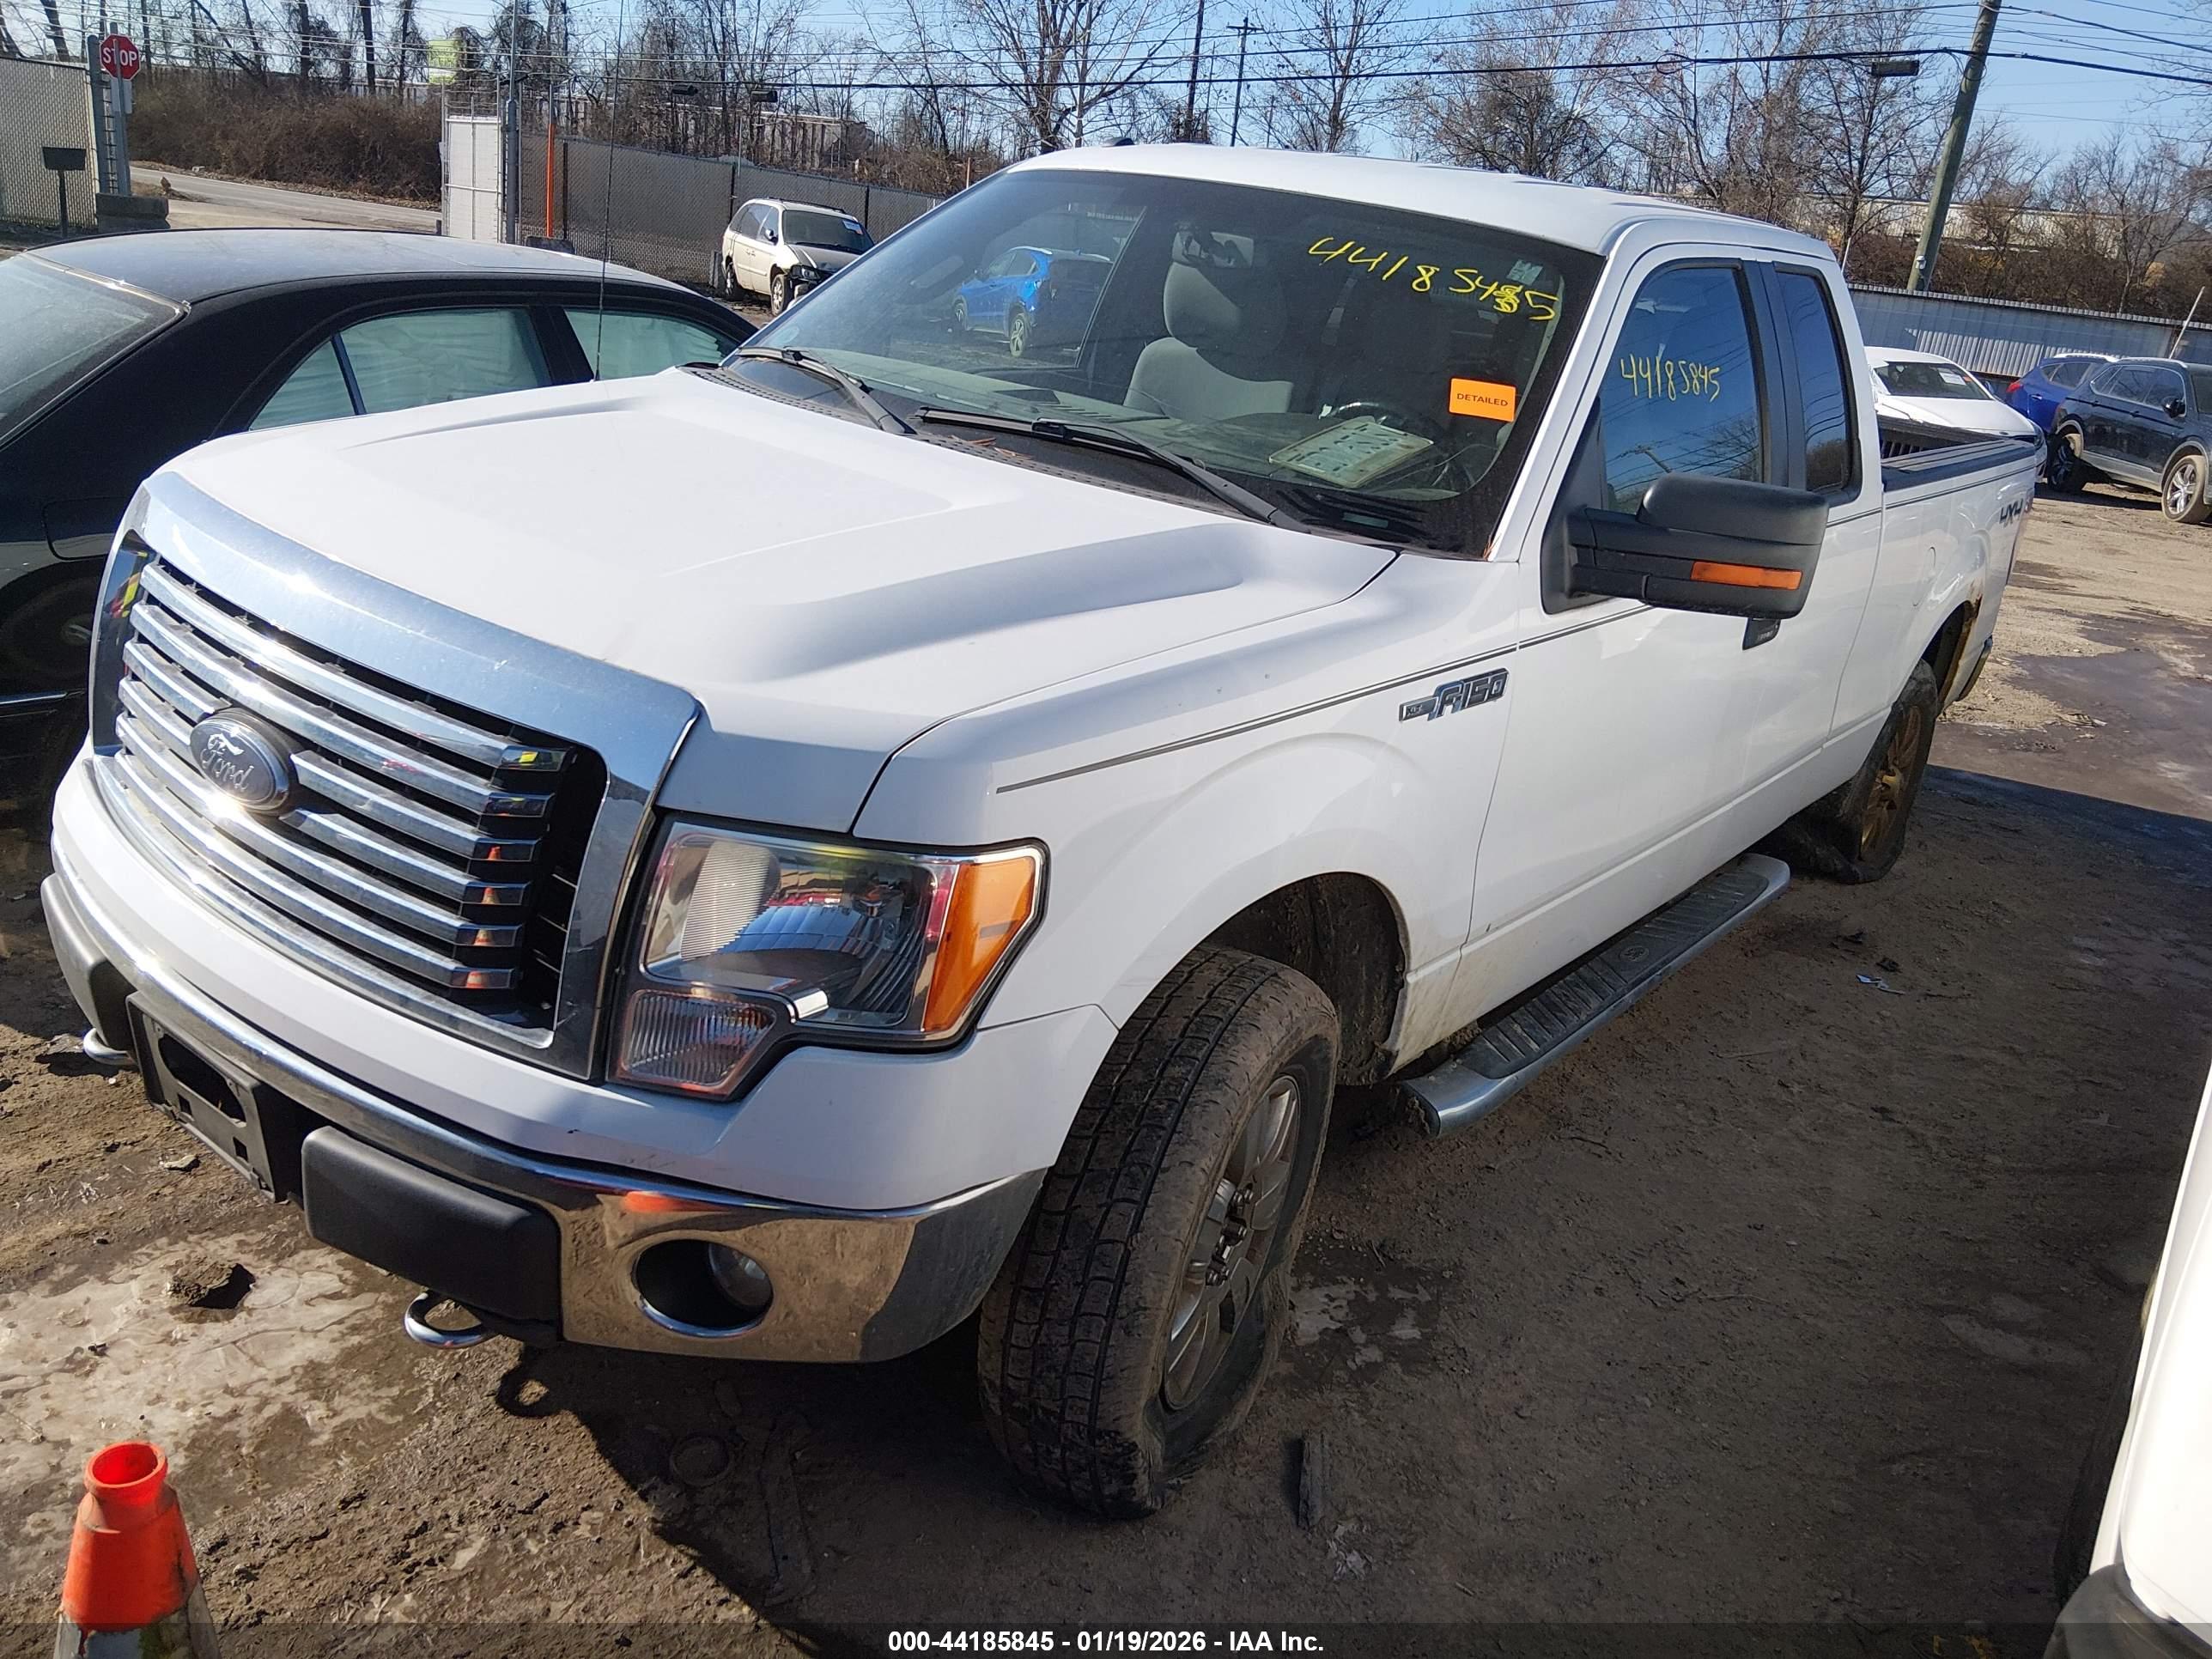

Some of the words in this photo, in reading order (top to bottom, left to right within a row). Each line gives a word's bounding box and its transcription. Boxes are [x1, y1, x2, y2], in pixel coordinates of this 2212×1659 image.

[1456, 392, 1509, 407] DETAILED
[1620, 353, 1721, 404] 44185845
[199, 732, 255, 792] Ford
